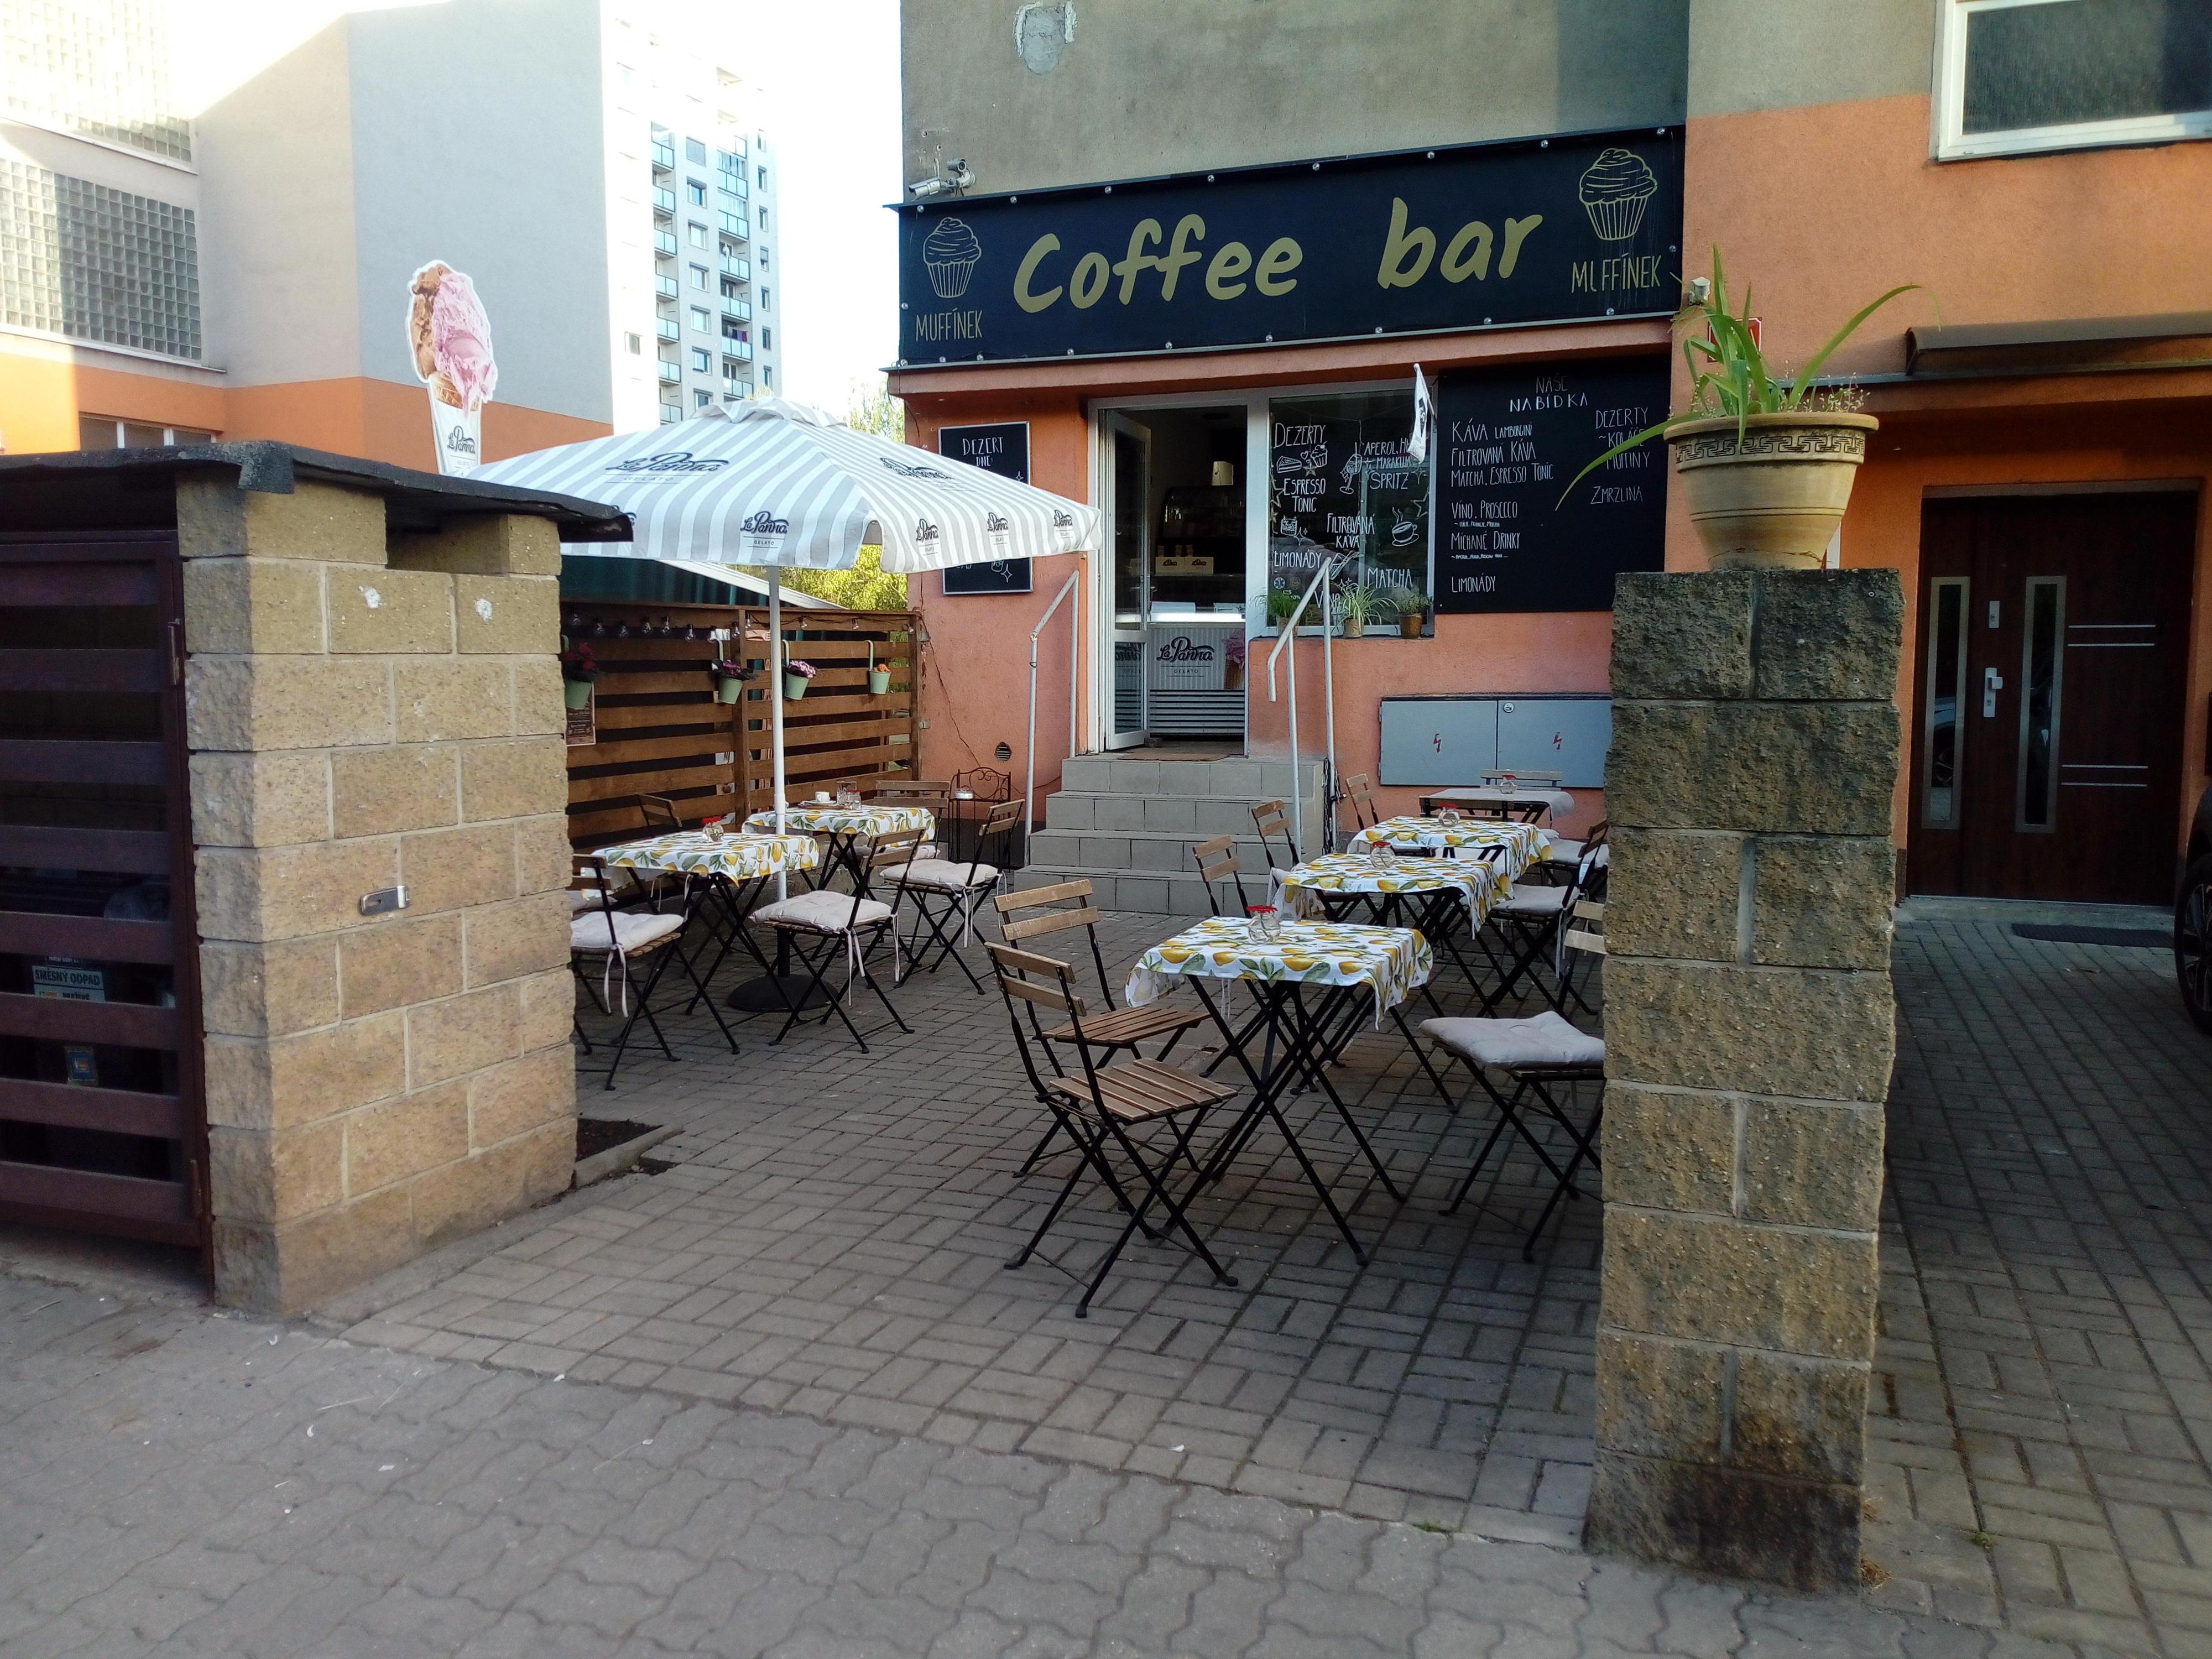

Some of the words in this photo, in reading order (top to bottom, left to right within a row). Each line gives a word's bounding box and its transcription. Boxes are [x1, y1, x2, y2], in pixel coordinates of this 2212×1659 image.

[1013, 213, 1303, 313] Coffee
[1377, 197, 1543, 289] bar
[916, 308, 983, 342] MUFFÍNEK
[1536, 373, 1568, 394] NAŠE
[1510, 392, 1588, 412] NABÍDKA
[1595, 407, 1648, 429] DEZERTY
[1273, 422, 1326, 448] DEZERTY
[1452, 418, 1488, 442] KÁVA
[963, 437, 1004, 456] DEZERT
[1451, 442, 1504, 467] FILTROVANÁ
[1511, 438, 1536, 462] KÁVA
[1370, 472, 1409, 489] SPRITZ
[1490, 466, 1527, 485] ESPRESSO
[1284, 478, 1326, 495] ESPRESSO
[1590, 486, 1643, 504] ZMRZLINA
[1292, 496, 1317, 512] TONIC
[1480, 500, 1517, 519] PROSECCO
[740, 517, 754, 531] La
[752, 511, 789, 534] Panna
[1327, 513, 1375, 535] FILTROVANÁ
[1451, 530, 1488, 550] MÍCHANÉ
[1494, 530, 1521, 550] DRINKY
[1274, 549, 1322, 568] LIMONÁDY
[1368, 567, 1412, 589] MATCHA
[1452, 572, 1496, 592] LIMONÁDY
[1156, 644, 1173, 661] La
[1170, 636, 1215, 663] Panna
